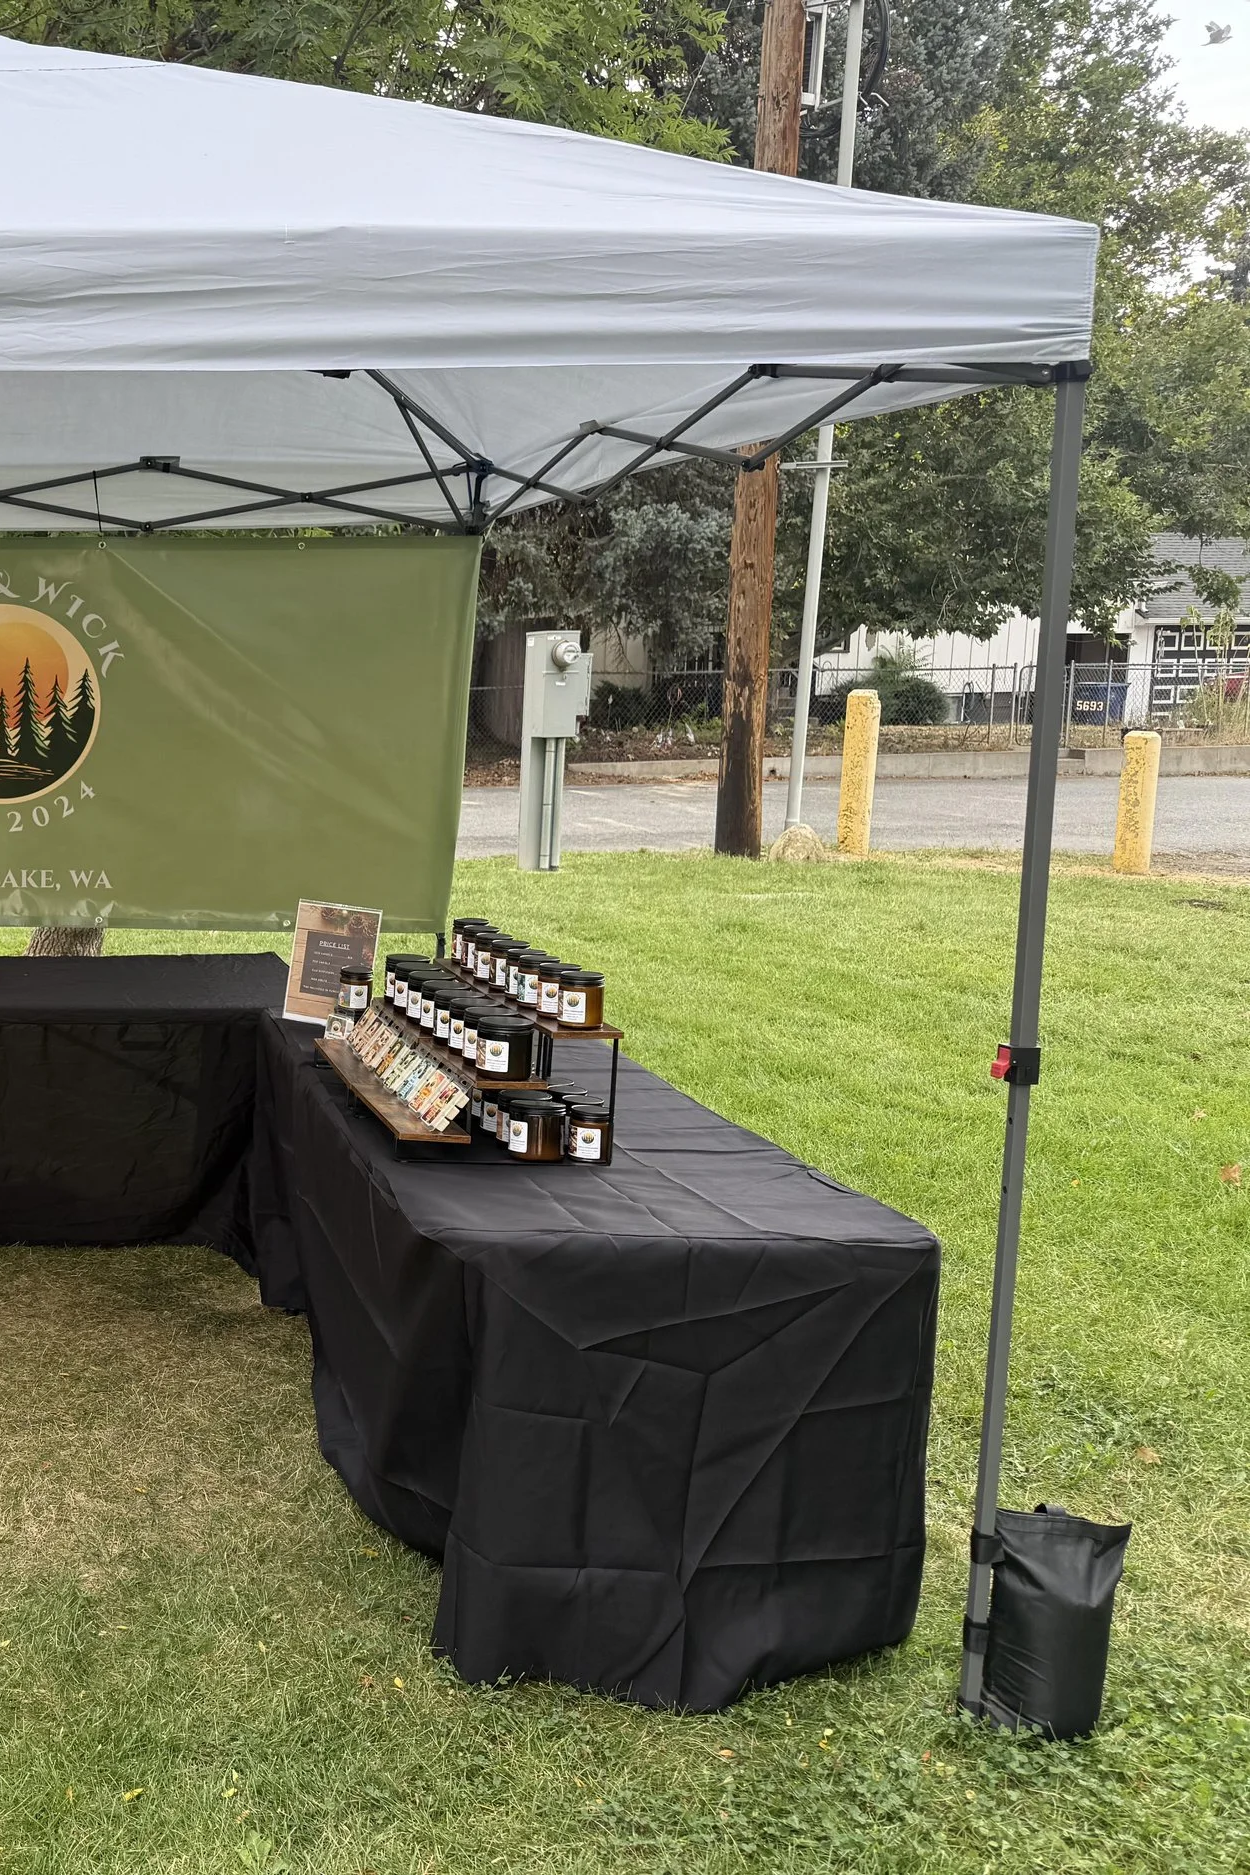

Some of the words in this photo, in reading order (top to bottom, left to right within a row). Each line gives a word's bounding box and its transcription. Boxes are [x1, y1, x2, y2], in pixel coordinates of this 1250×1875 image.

[30, 576, 126, 679] WICK
[1076, 700, 1104, 711] 5693
[7, 779, 96, 833] 2024
[69, 869, 113, 889] WA
[319, 940, 337, 948] PRICE
